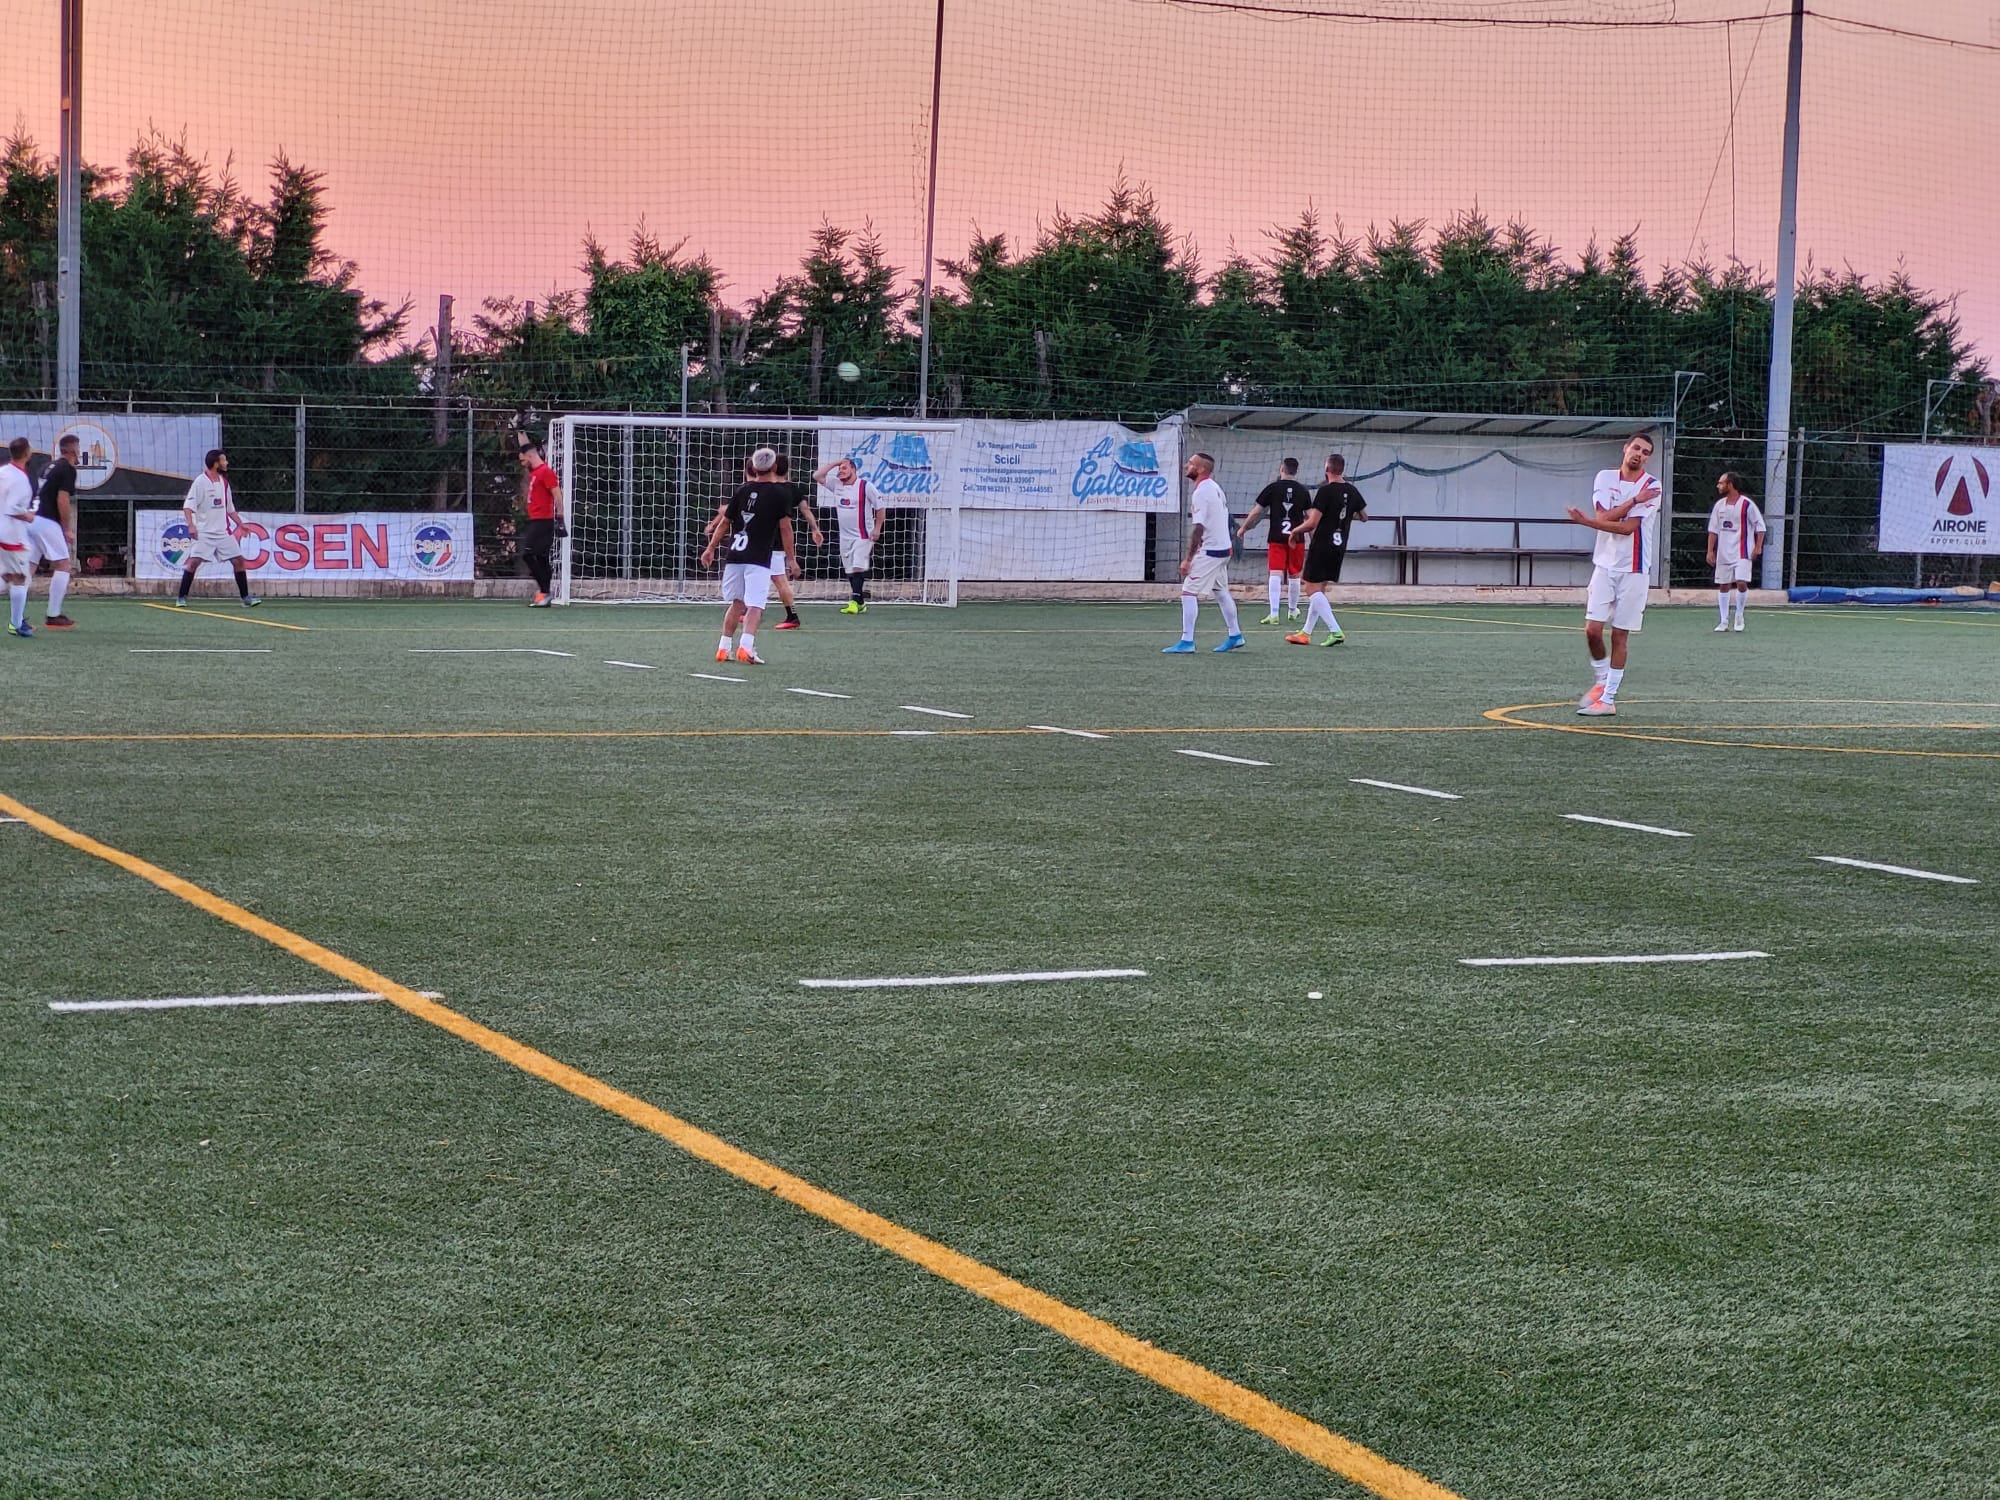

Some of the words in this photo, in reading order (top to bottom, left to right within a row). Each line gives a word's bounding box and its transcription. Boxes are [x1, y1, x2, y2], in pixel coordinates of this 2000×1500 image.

[851, 433, 881, 457] Al
[1086, 436, 1114, 460] Al
[994, 454, 1021, 465] Scicli
[1072, 457, 1168, 504] Galeone
[1281, 521, 1292, 535] 2
[1932, 519, 1987, 533] AIRONE
[160, 537, 192, 552] cse
[232, 522, 390, 571] CSEN
[413, 539, 454, 554] csen
[731, 533, 749, 552] 10
[1964, 538, 1987, 546] CLUB
